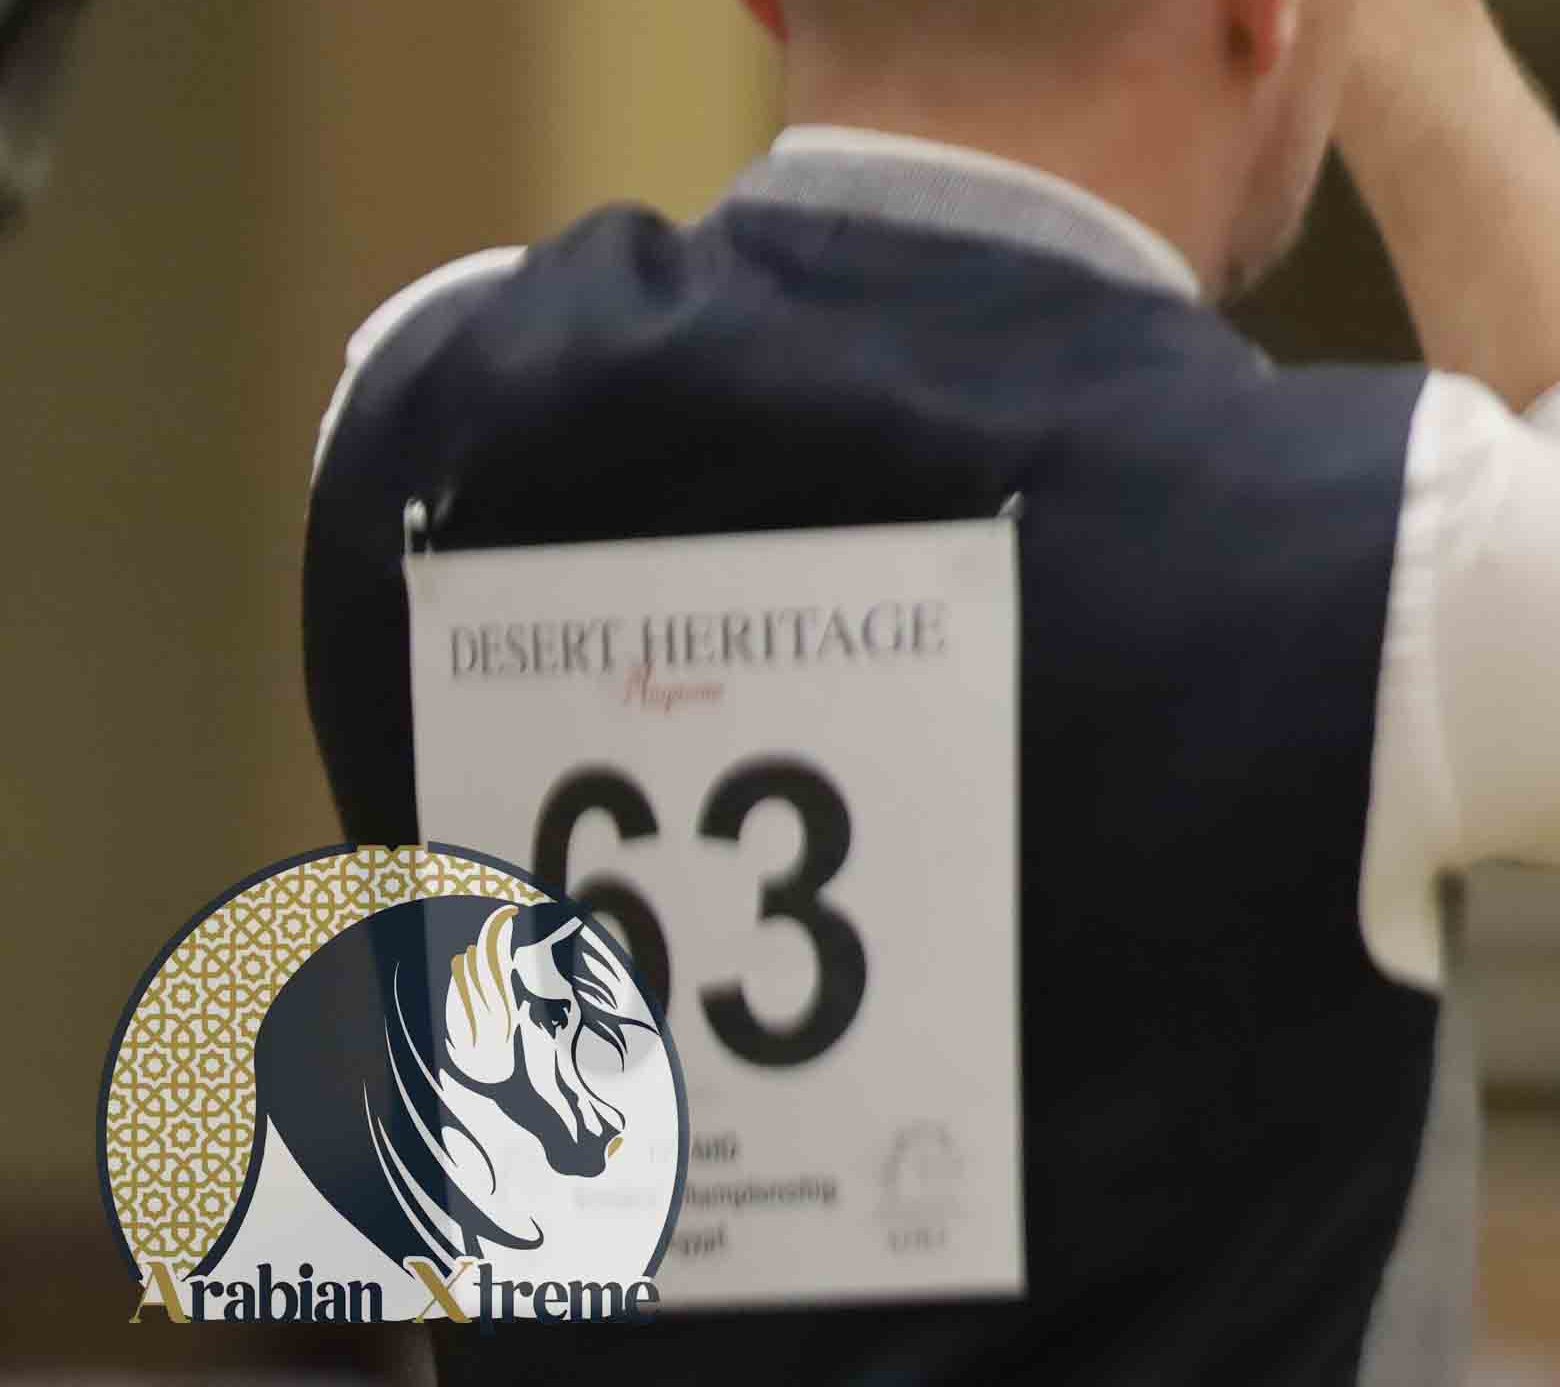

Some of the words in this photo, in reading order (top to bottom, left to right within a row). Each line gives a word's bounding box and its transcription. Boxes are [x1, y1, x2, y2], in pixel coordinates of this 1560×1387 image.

[449, 618, 621, 678] DESERT
[637, 601, 946, 670] HERITAGE
[531, 752, 868, 1068] 63
[672, 1175, 839, 1210] hampionship
